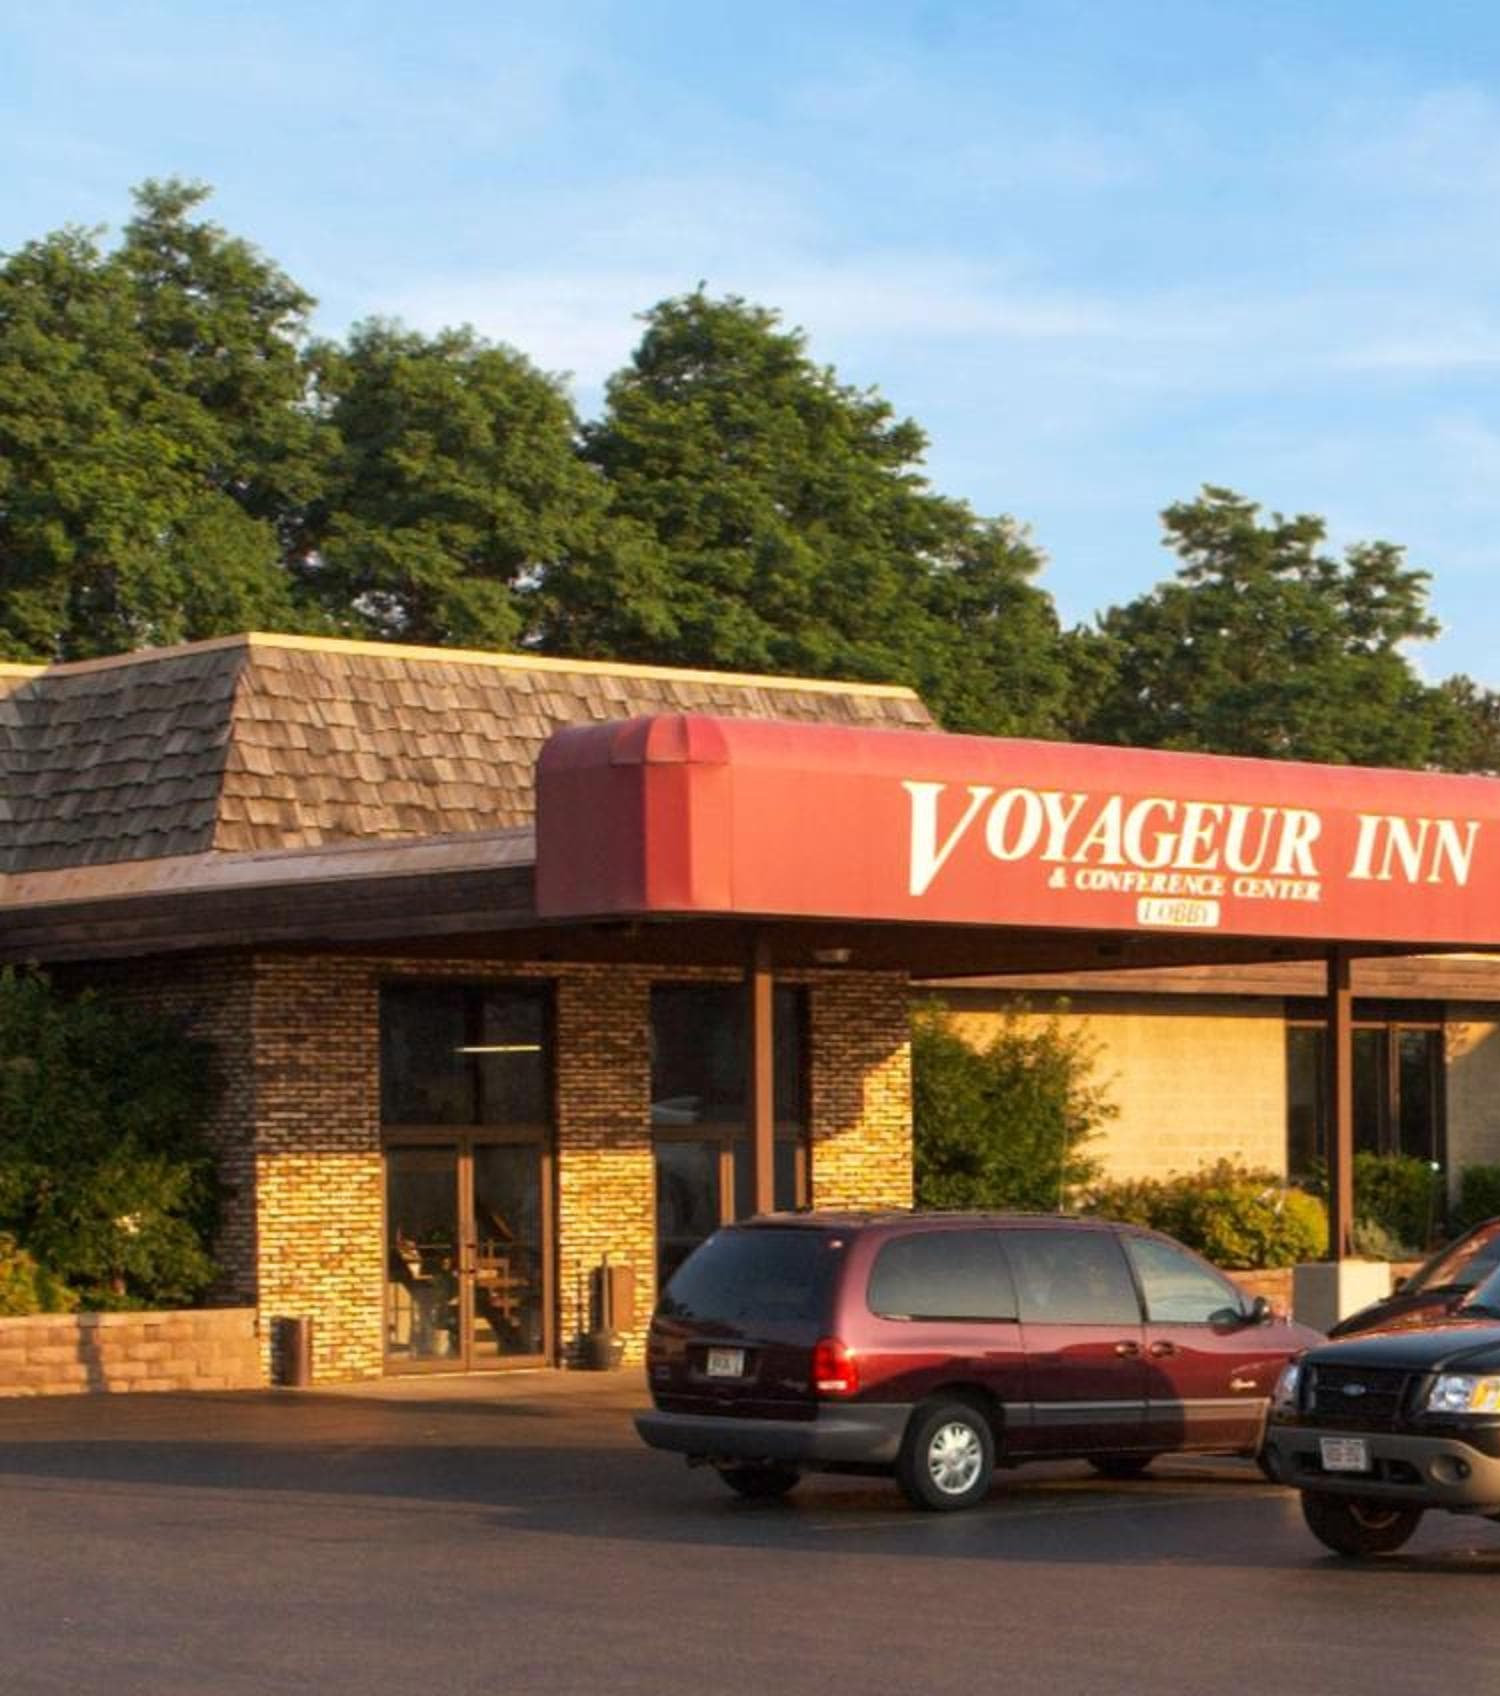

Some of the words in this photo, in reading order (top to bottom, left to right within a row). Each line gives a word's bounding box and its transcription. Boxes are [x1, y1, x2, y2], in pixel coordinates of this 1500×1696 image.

[901, 780, 1322, 896] VOYAGEUR
[1347, 814, 1481, 887] INN
[1049, 867, 1066, 889] &
[1075, 869, 1226, 897] CONFERENCE
[1233, 876, 1321, 902] CENTER
[1144, 901, 1209, 924] LOBBY
